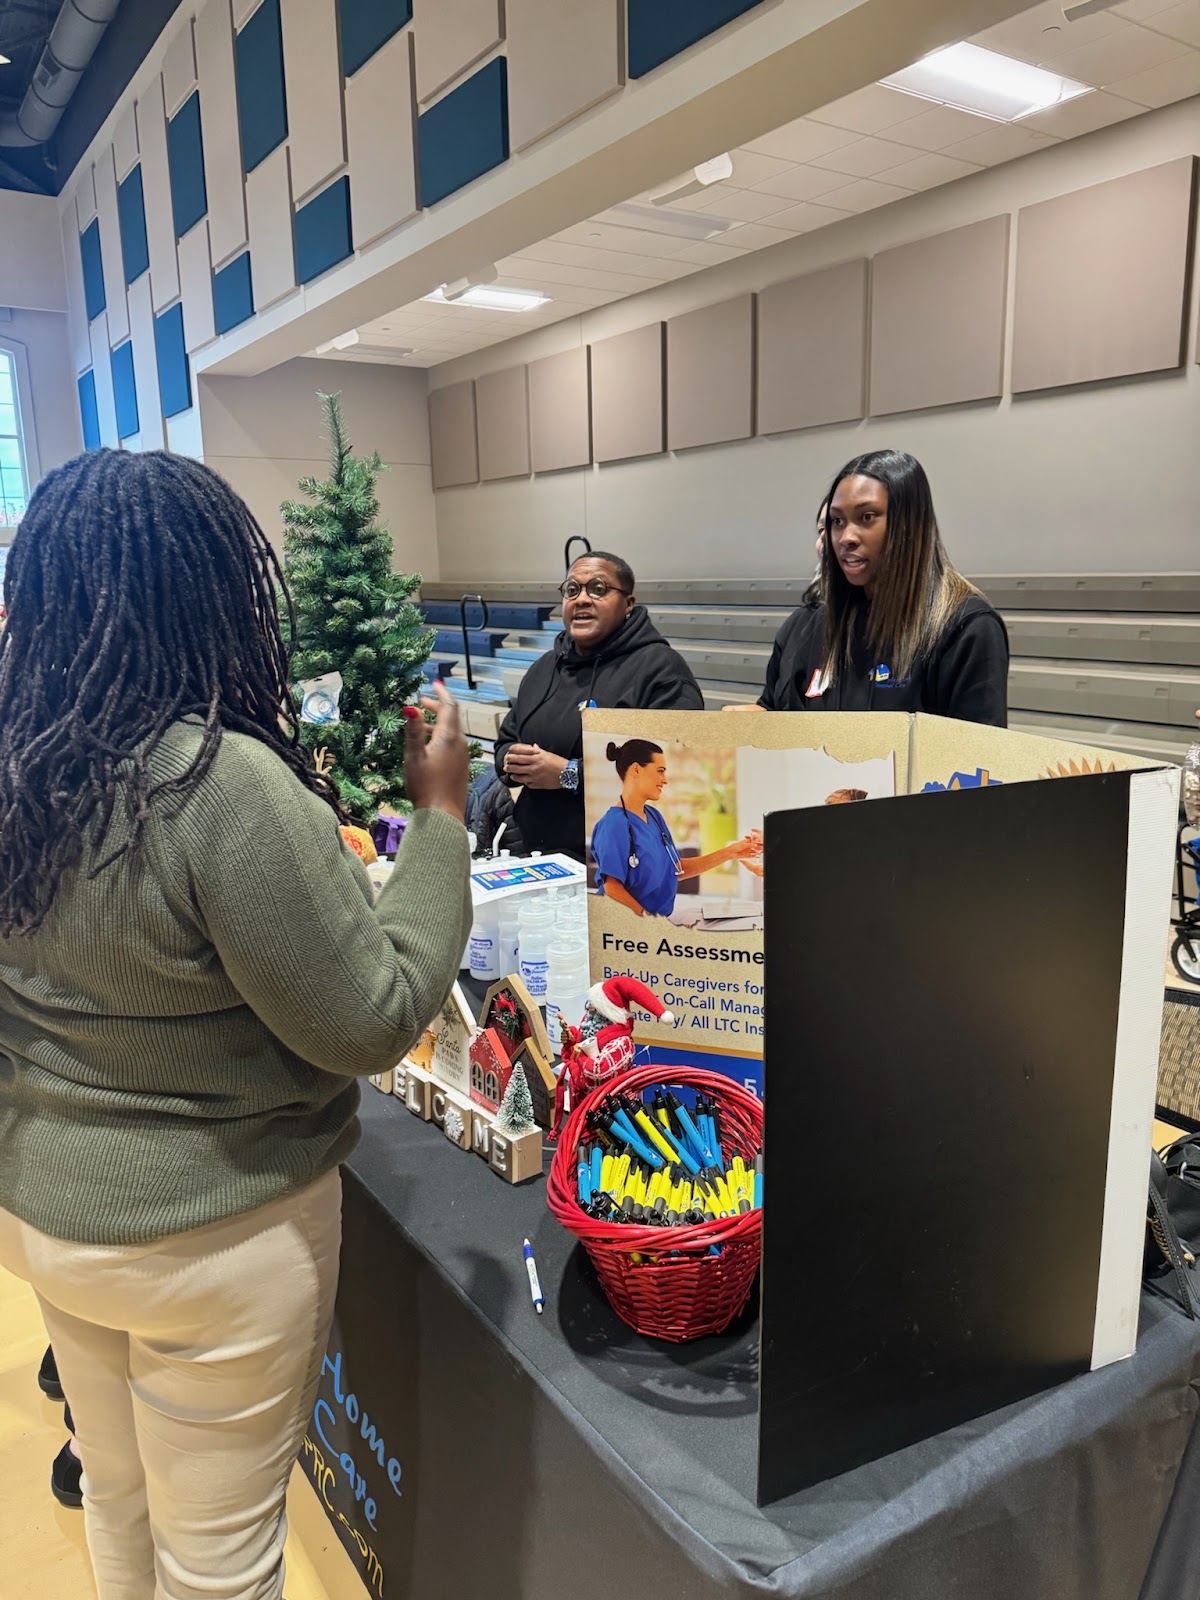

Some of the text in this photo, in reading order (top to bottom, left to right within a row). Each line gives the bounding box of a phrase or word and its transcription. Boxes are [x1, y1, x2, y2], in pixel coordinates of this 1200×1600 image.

[602, 933, 764, 964] Free Assessme
[663, 973, 740, 993] Caregivers
[663, 993, 715, 1011] On-Call
[691, 1016, 709, 1029] All
[714, 1018, 740, 1033] LTC
[436, 1027, 461, 1054] Santa
[320, 1352, 402, 1497] Home
[314, 1398, 378, 1533] Care
